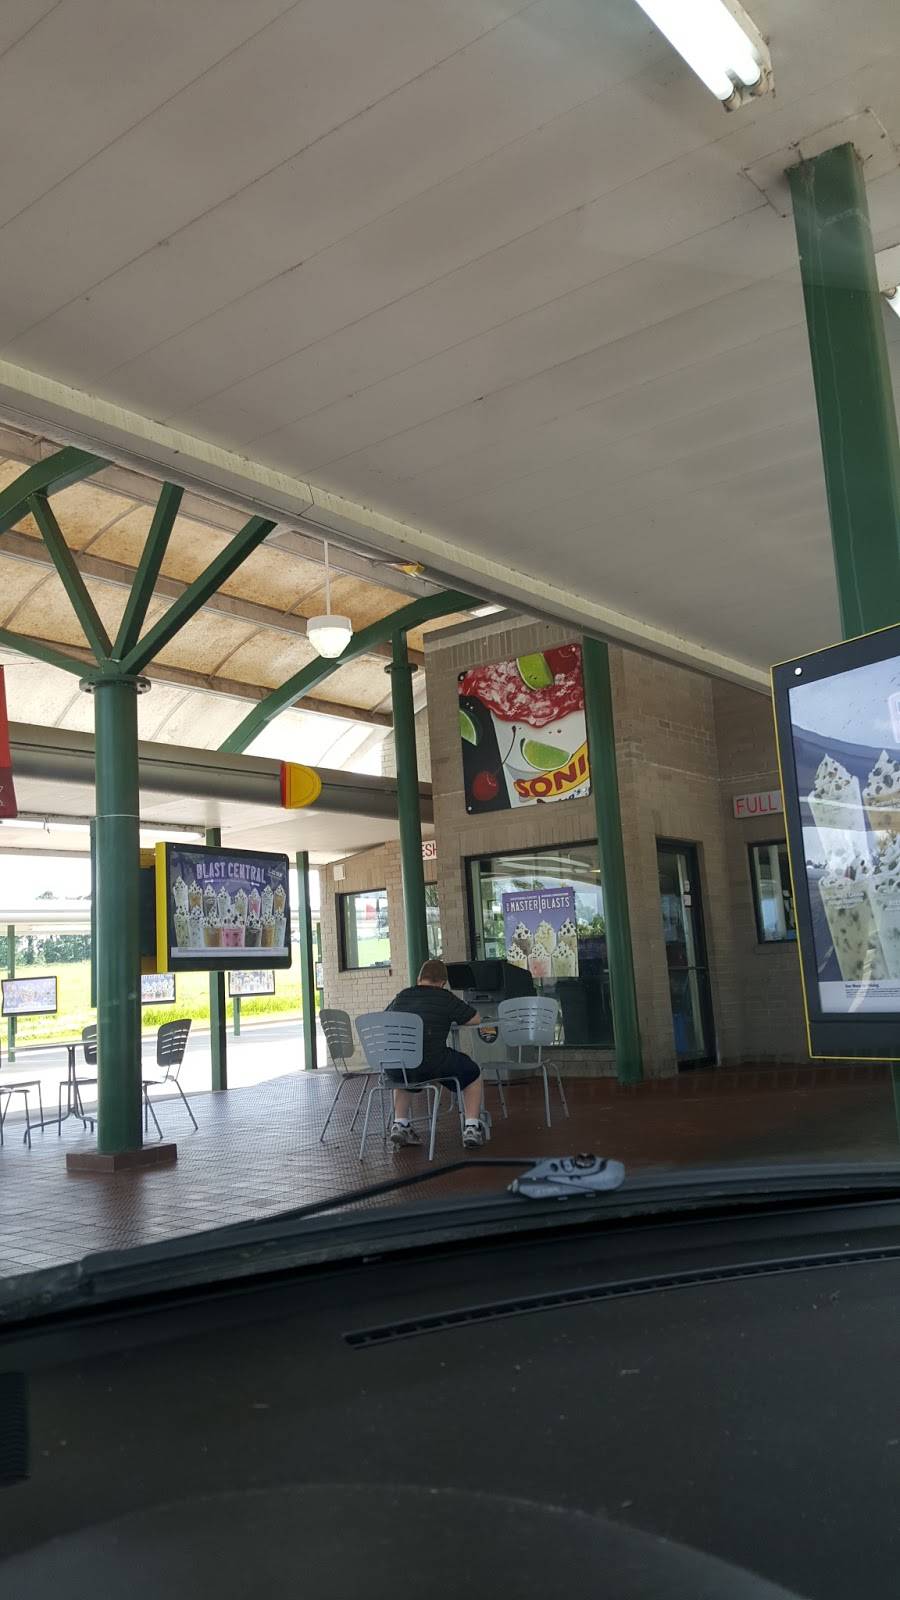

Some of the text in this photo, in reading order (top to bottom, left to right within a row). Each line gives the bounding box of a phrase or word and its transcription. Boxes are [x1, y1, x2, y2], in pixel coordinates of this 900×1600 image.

[736, 793, 777, 816] FULL
[196, 862, 226, 880] BLAST
[227, 862, 267, 884] CENTRAL
[510, 899, 538, 912] MASTER
[541, 897, 570, 910] BLASTS
